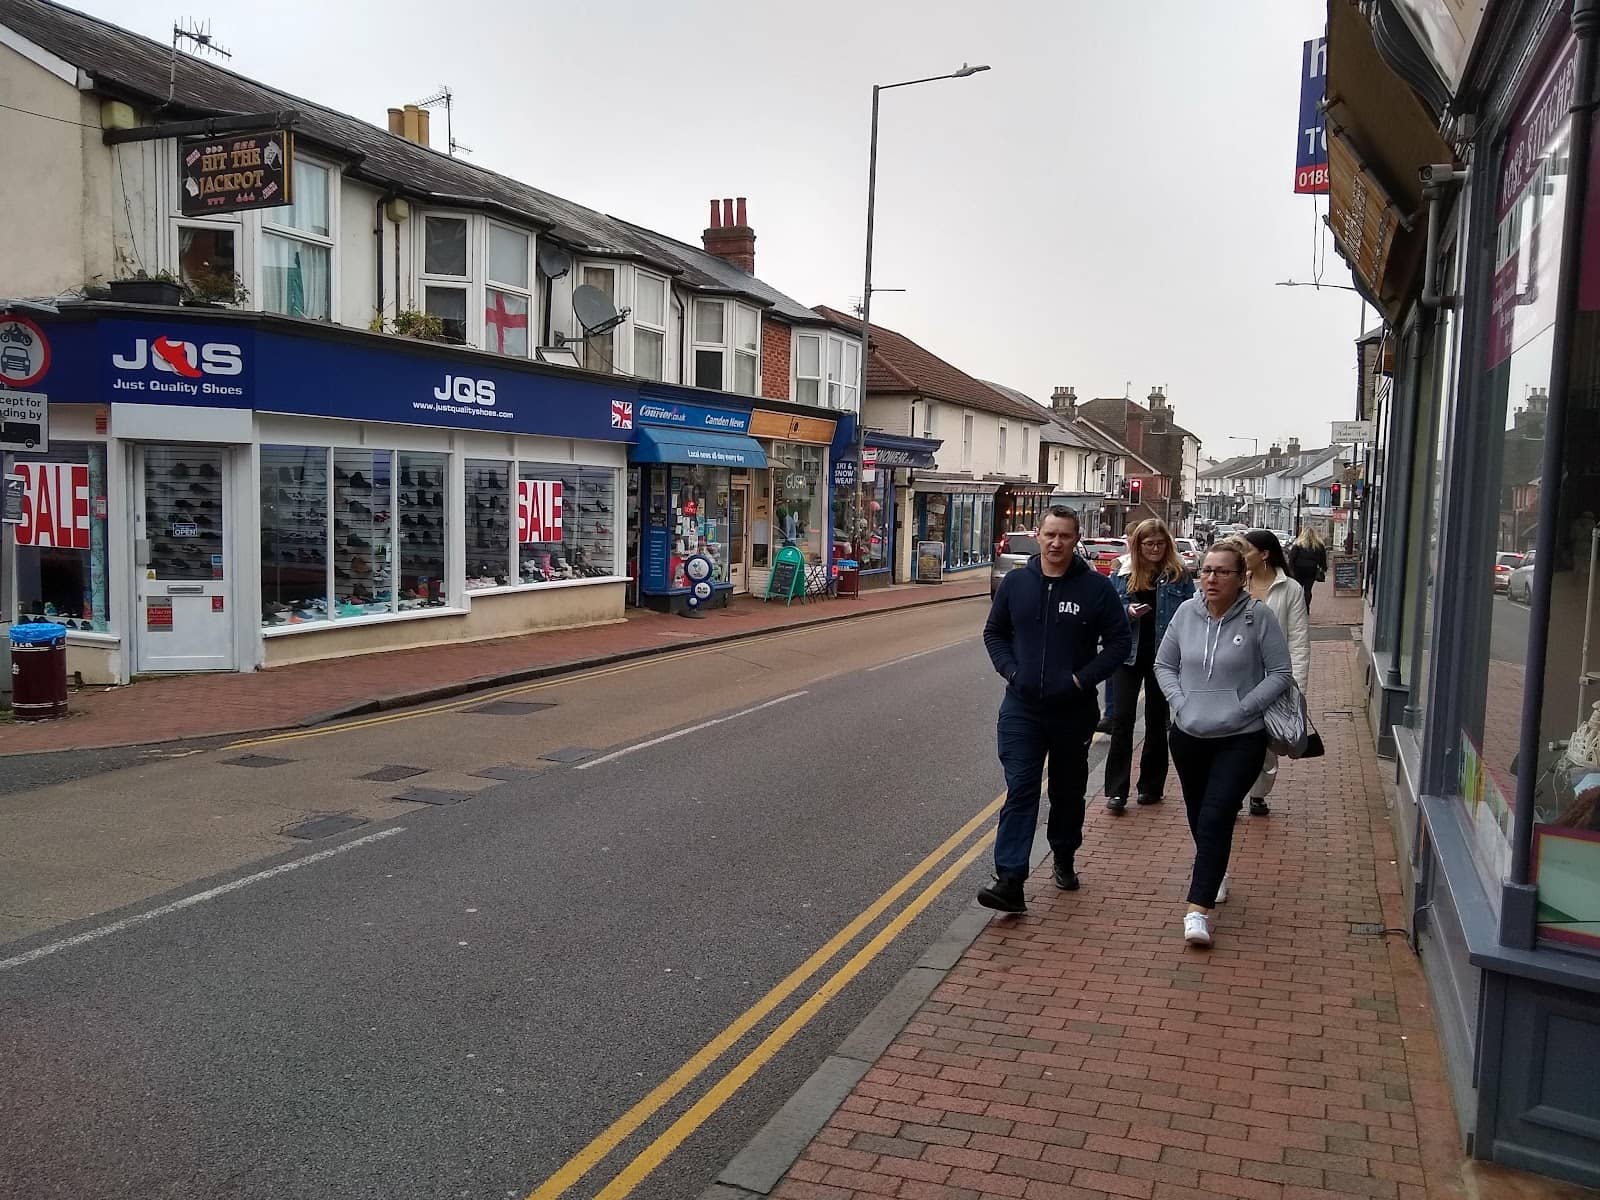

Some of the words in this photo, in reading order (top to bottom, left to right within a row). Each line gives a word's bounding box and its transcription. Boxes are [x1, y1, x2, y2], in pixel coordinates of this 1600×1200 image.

[201, 152, 228, 172] HIT
[231, 148, 261, 168] THE
[1502, 140, 1524, 209] ROSE
[198, 169, 265, 200] JACKPOT
[112, 379, 145, 390] Just
[150, 381, 198, 395] Quality
[202, 383, 243, 395] Shoes
[434, 374, 496, 406] JQS
[26, 397, 41, 407] for
[29, 409, 42, 421] by
[412, 402, 514, 419] www.justqualityshoes.com
[705, 414, 729, 427] Camden
[729, 417, 745, 428] News
[687, 449, 699, 458] Local
[700, 451, 711, 459] news
[717, 452, 725, 462] day
[725, 454, 737, 463] every
[737, 453, 745, 463] day
[836, 462, 847, 470] SKI
[847, 462, 852, 470] &
[834, 477, 853, 485] WEAR
[14, 464, 90, 549] SALE
[518, 481, 562, 541] SALE
[1058, 601, 1080, 615] GAP
